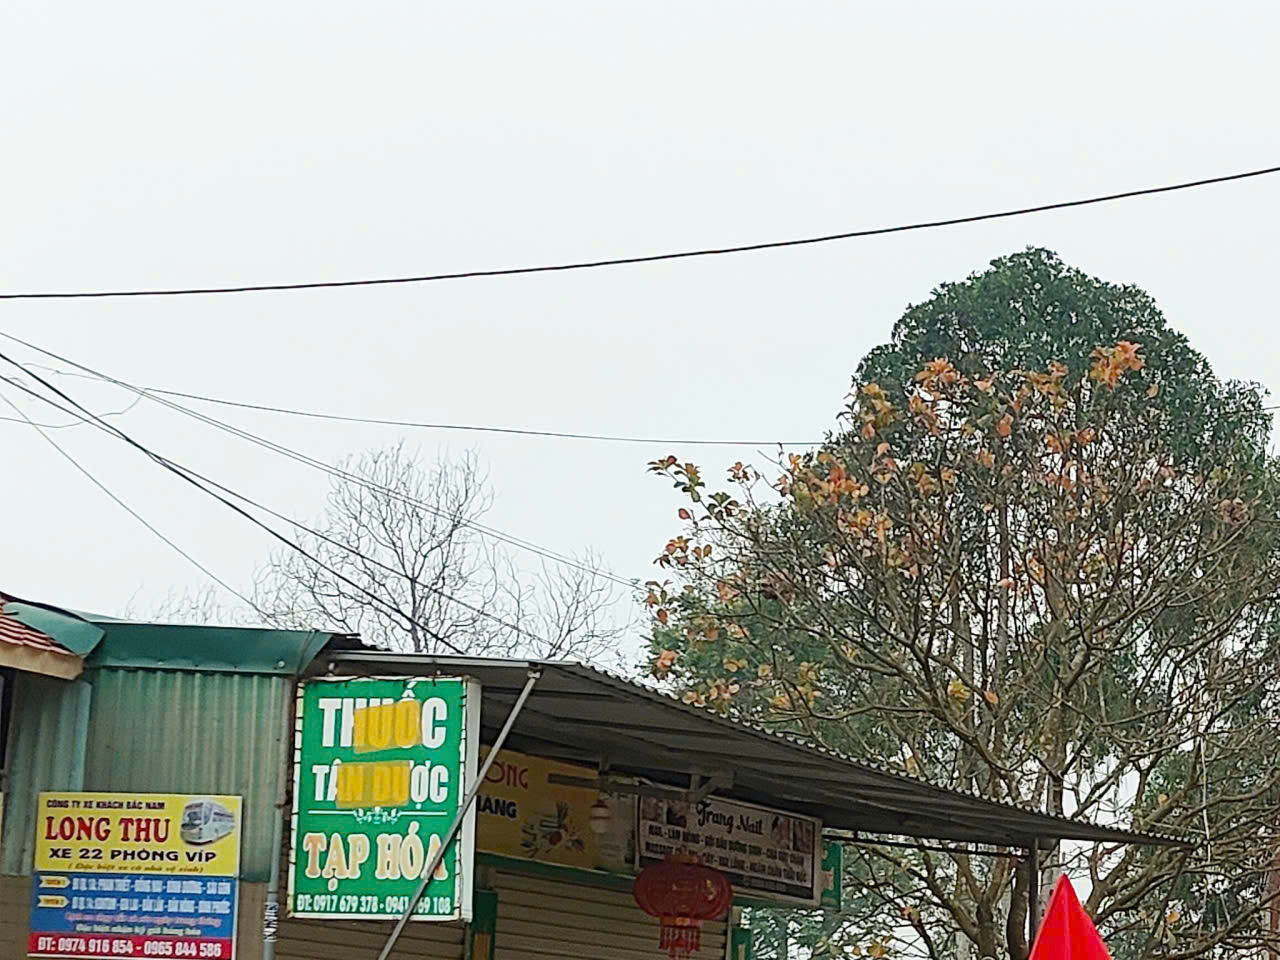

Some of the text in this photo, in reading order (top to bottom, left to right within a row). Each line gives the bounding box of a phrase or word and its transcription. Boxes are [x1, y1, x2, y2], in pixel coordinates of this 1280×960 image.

[45, 816, 171, 842] LONG THU
[696, 801, 763, 835] Trang Nail
[49, 848, 72, 858] XE
[79, 848, 103, 859] 22
[303, 820, 448, 891] TẠP HÓA
[313, 894, 338, 911] 0917
[340, 895, 358, 912] 679
[360, 895, 378, 913] 378
[433, 896, 451, 914] 108
[58, 937, 85, 952] 0974
[88, 938, 110, 953] 916
[112, 939, 133, 954] 854
[175, 942, 197, 956] 844
